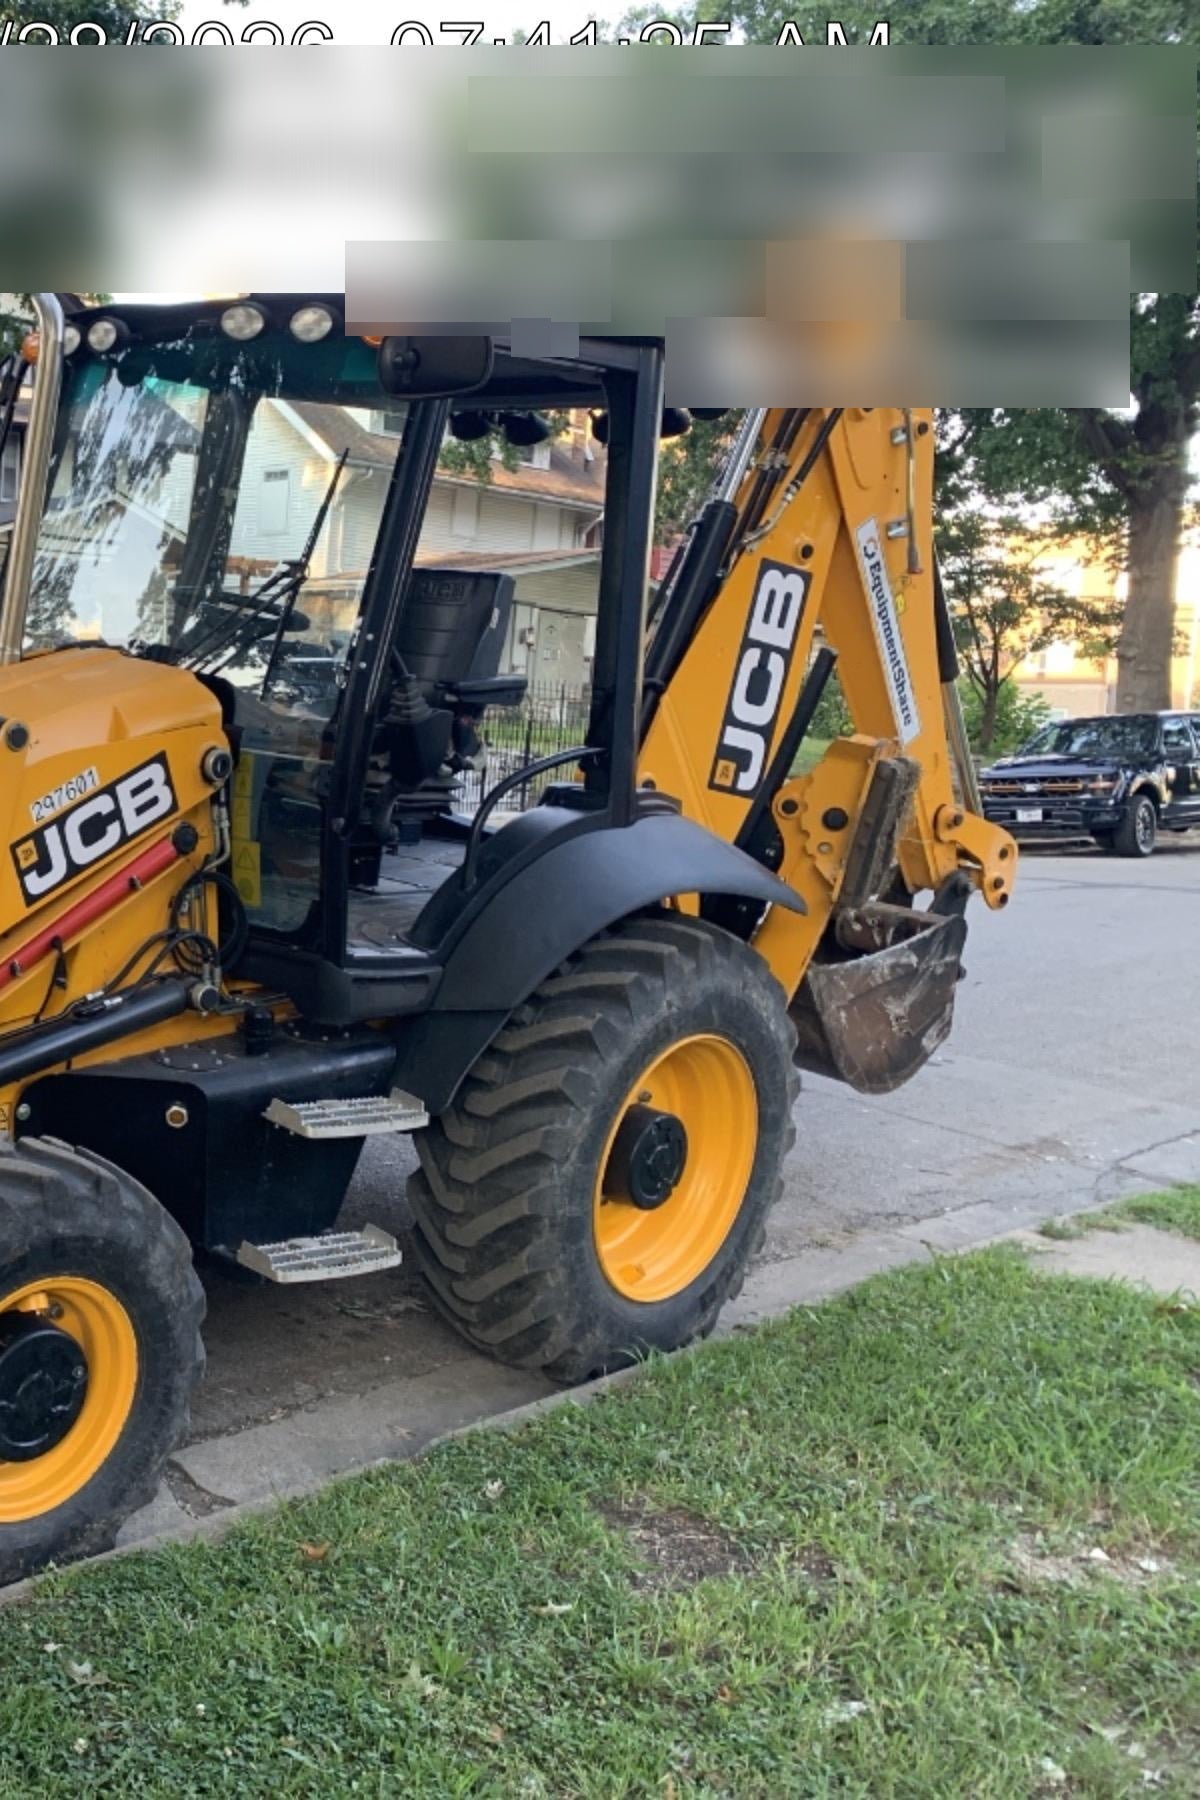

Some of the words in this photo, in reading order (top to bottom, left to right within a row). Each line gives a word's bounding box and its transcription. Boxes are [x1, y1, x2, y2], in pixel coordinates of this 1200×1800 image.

[723, 569, 804, 791] JCB
[869, 560, 912, 726] EquipmentShare
[23, 763, 173, 895] JCB
[31, 770, 98, 821] 297601
